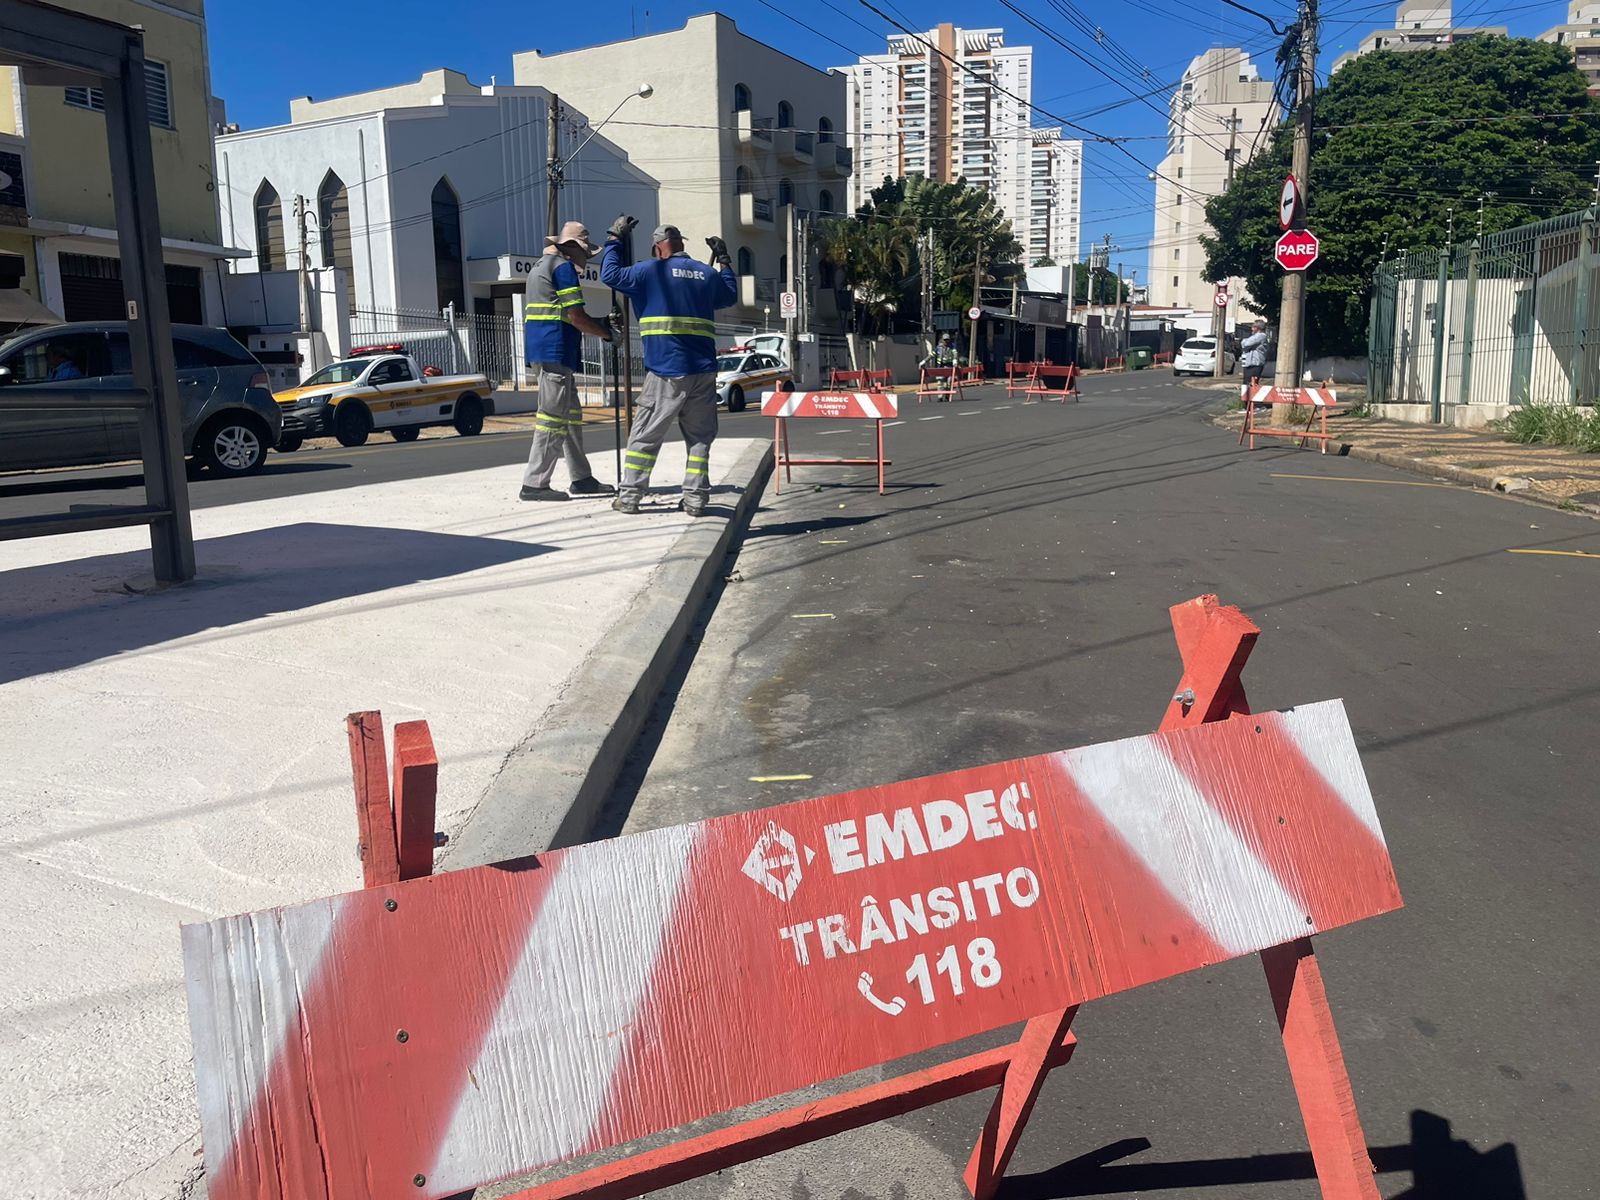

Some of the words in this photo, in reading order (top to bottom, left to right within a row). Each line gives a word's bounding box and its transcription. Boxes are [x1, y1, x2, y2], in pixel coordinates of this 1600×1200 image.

[671, 268, 706, 281] EMDEC
[1278, 244, 1316, 256] PARE
[823, 781, 1038, 875] EMDEC
[779, 866, 1040, 966] TRÂNSITO
[905, 937, 1002, 1005] 118
